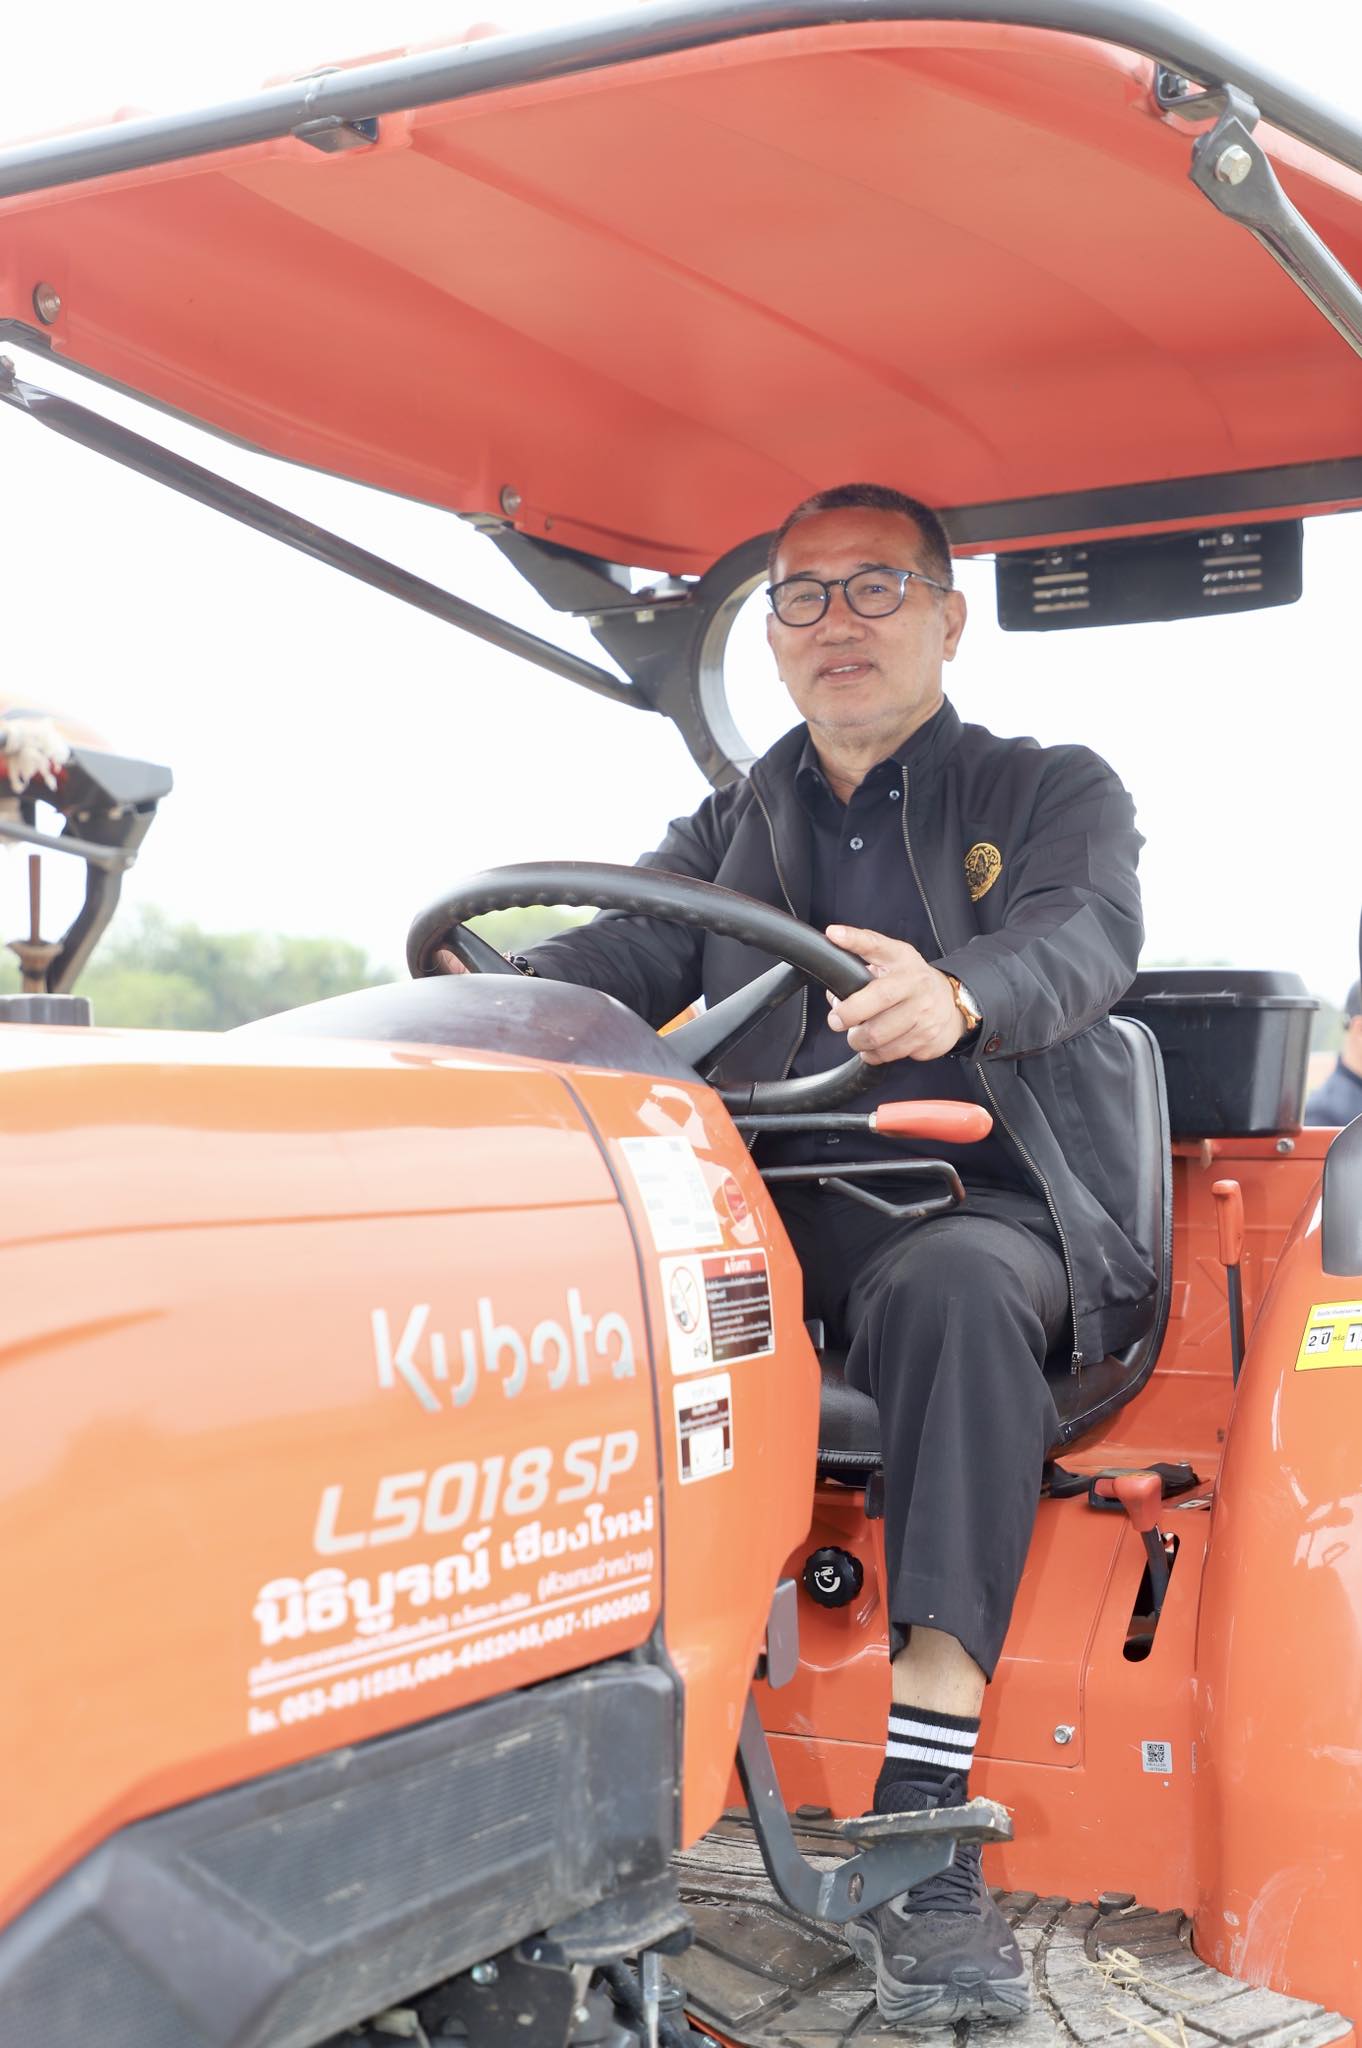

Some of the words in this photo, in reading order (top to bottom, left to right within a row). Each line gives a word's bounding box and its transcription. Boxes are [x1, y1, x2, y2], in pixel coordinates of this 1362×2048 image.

[371, 1287, 636, 1413] Kubota
[252, 1526, 492, 1646] นิธิบูรณ์
[500, 1495, 654, 1569] เชียงใหม่
